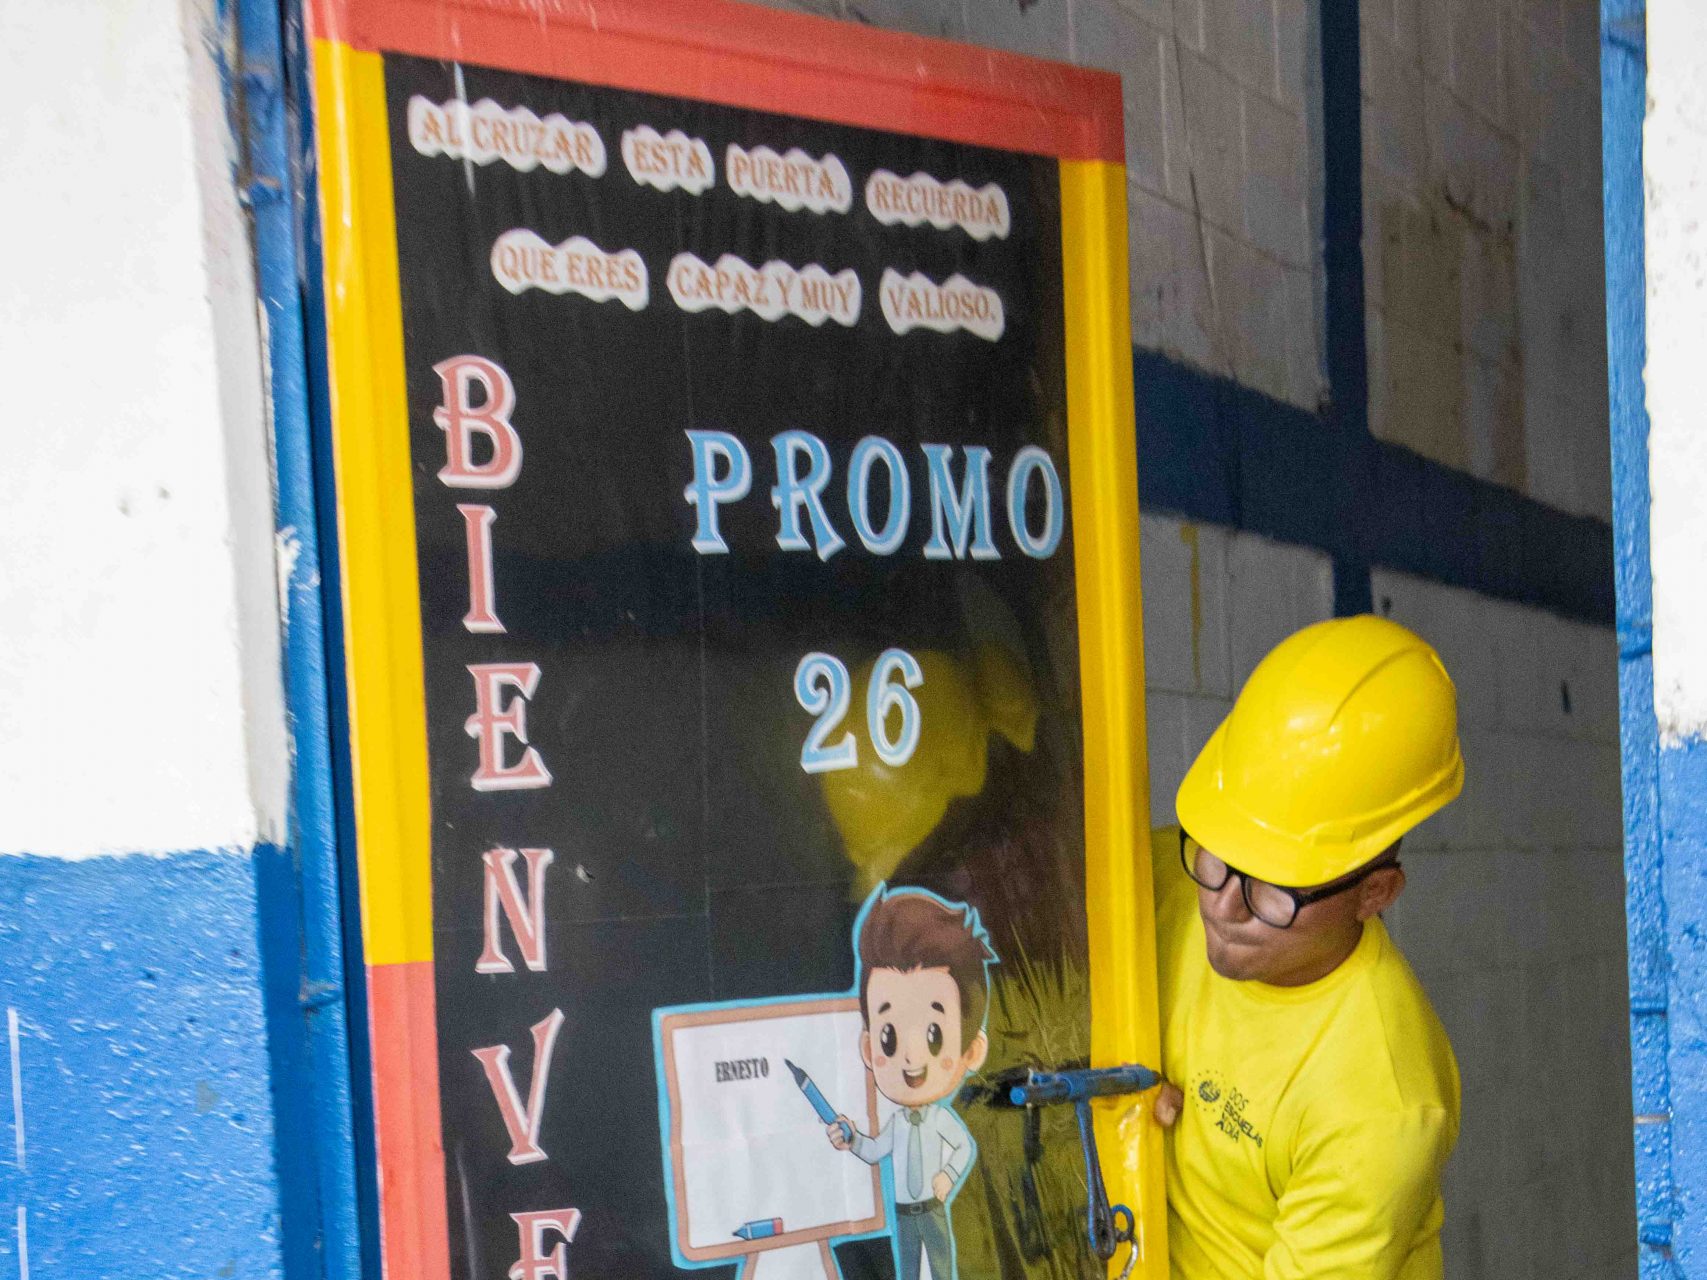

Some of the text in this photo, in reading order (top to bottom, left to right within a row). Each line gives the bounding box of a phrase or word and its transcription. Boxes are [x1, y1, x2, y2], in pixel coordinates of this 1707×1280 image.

[422, 109, 461, 147] AL
[470, 116, 595, 166] CRUZAR
[631, 138, 706, 178] ESTA
[873, 178, 1003, 225] RECUERDA
[499, 244, 560, 282] QUE
[565, 251, 642, 293] ERES
[675, 264, 769, 306] CAPAZ
[776, 272, 795, 307] Y
[801, 276, 855, 315] MUY
[683, 428, 1064, 563] PROMO
[793, 646, 924, 774] 26
[714, 1056, 769, 1083] ERNESTO
